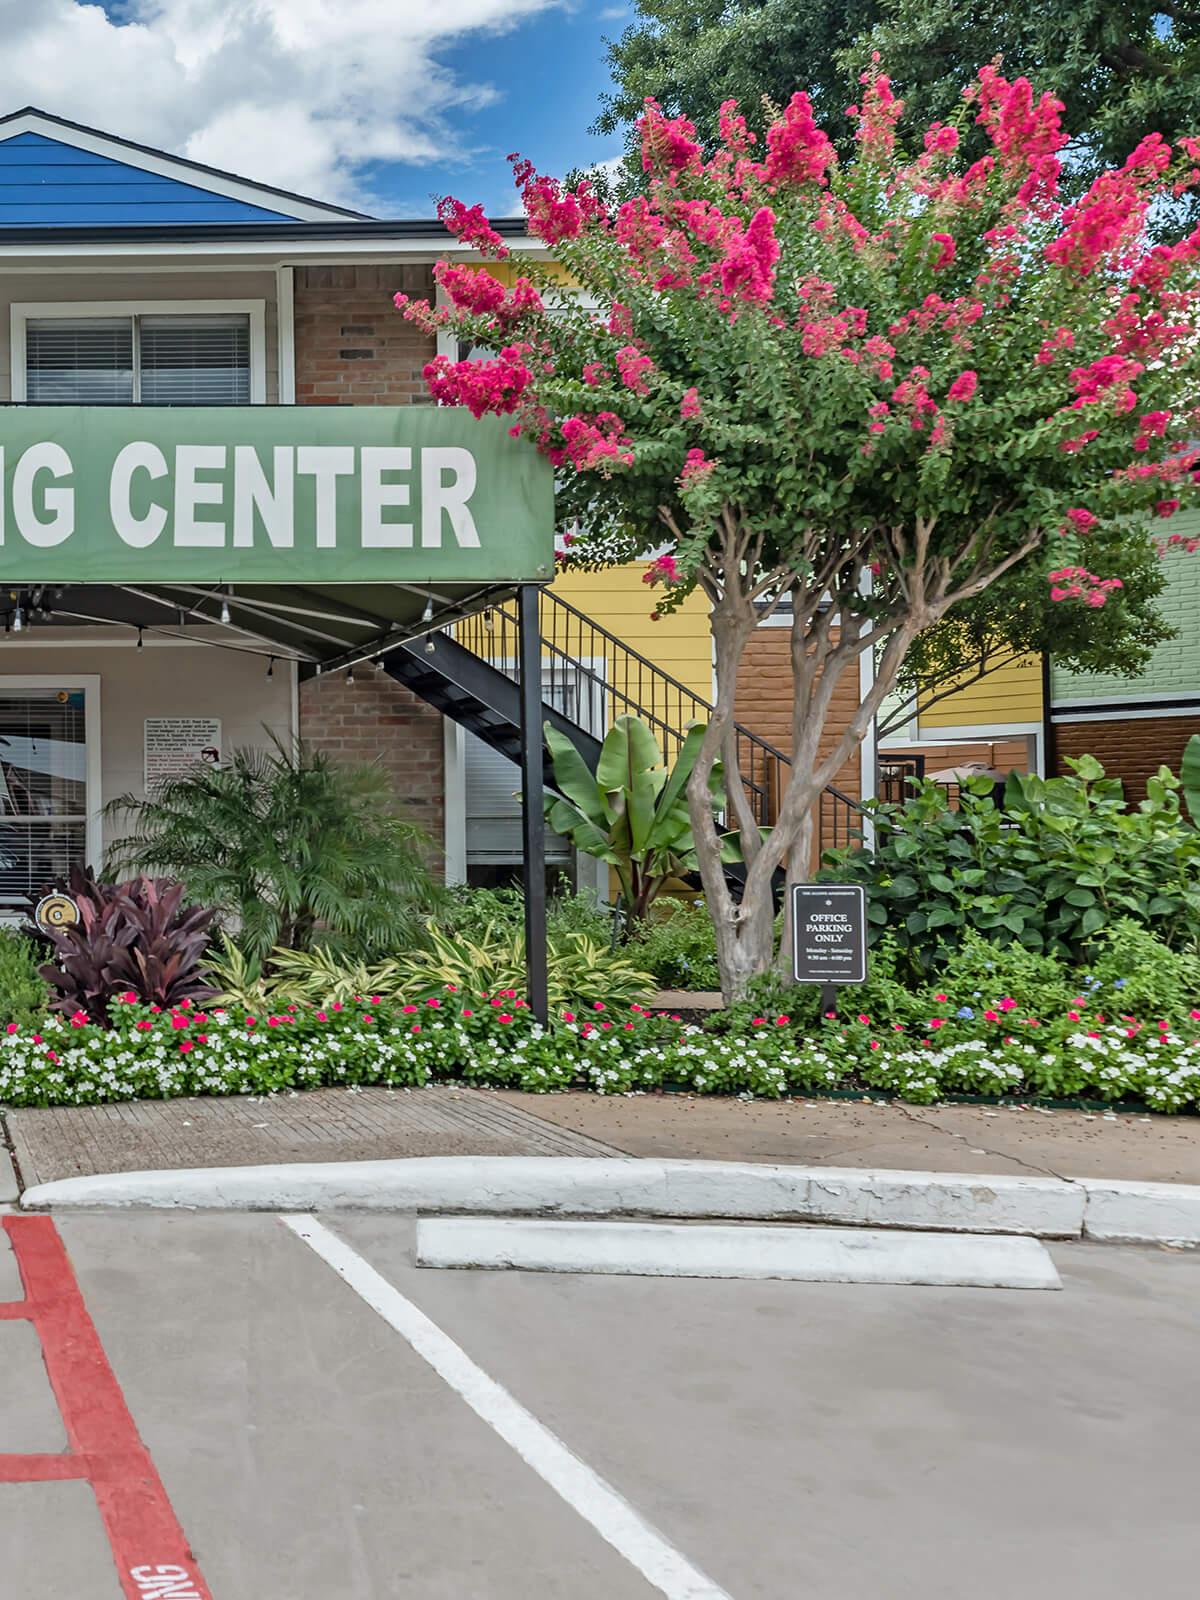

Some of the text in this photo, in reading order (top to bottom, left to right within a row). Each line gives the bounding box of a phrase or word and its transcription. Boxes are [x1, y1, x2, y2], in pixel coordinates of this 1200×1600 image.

[110, 441, 481, 548] CENTER
[810, 914, 848, 922] OFFICE
[806, 924, 853, 933] PARKING
[814, 934, 845, 943] ONLY
[130, 1565, 202, 1600] NG
